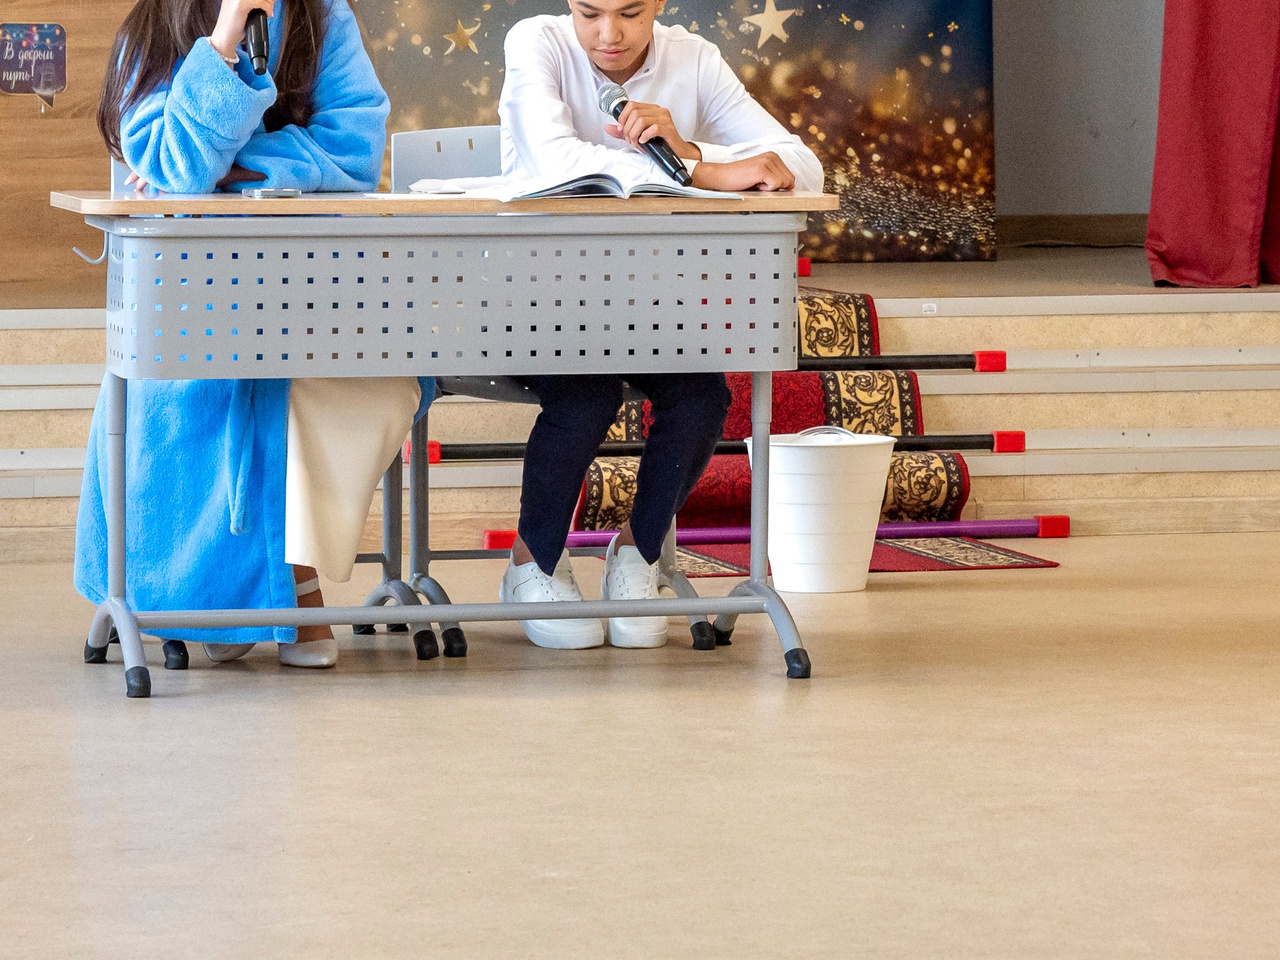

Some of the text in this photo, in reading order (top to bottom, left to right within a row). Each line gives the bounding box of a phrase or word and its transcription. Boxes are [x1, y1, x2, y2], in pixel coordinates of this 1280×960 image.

[3, 41, 54, 68] В добрый
[2, 66, 34, 90] путь!
